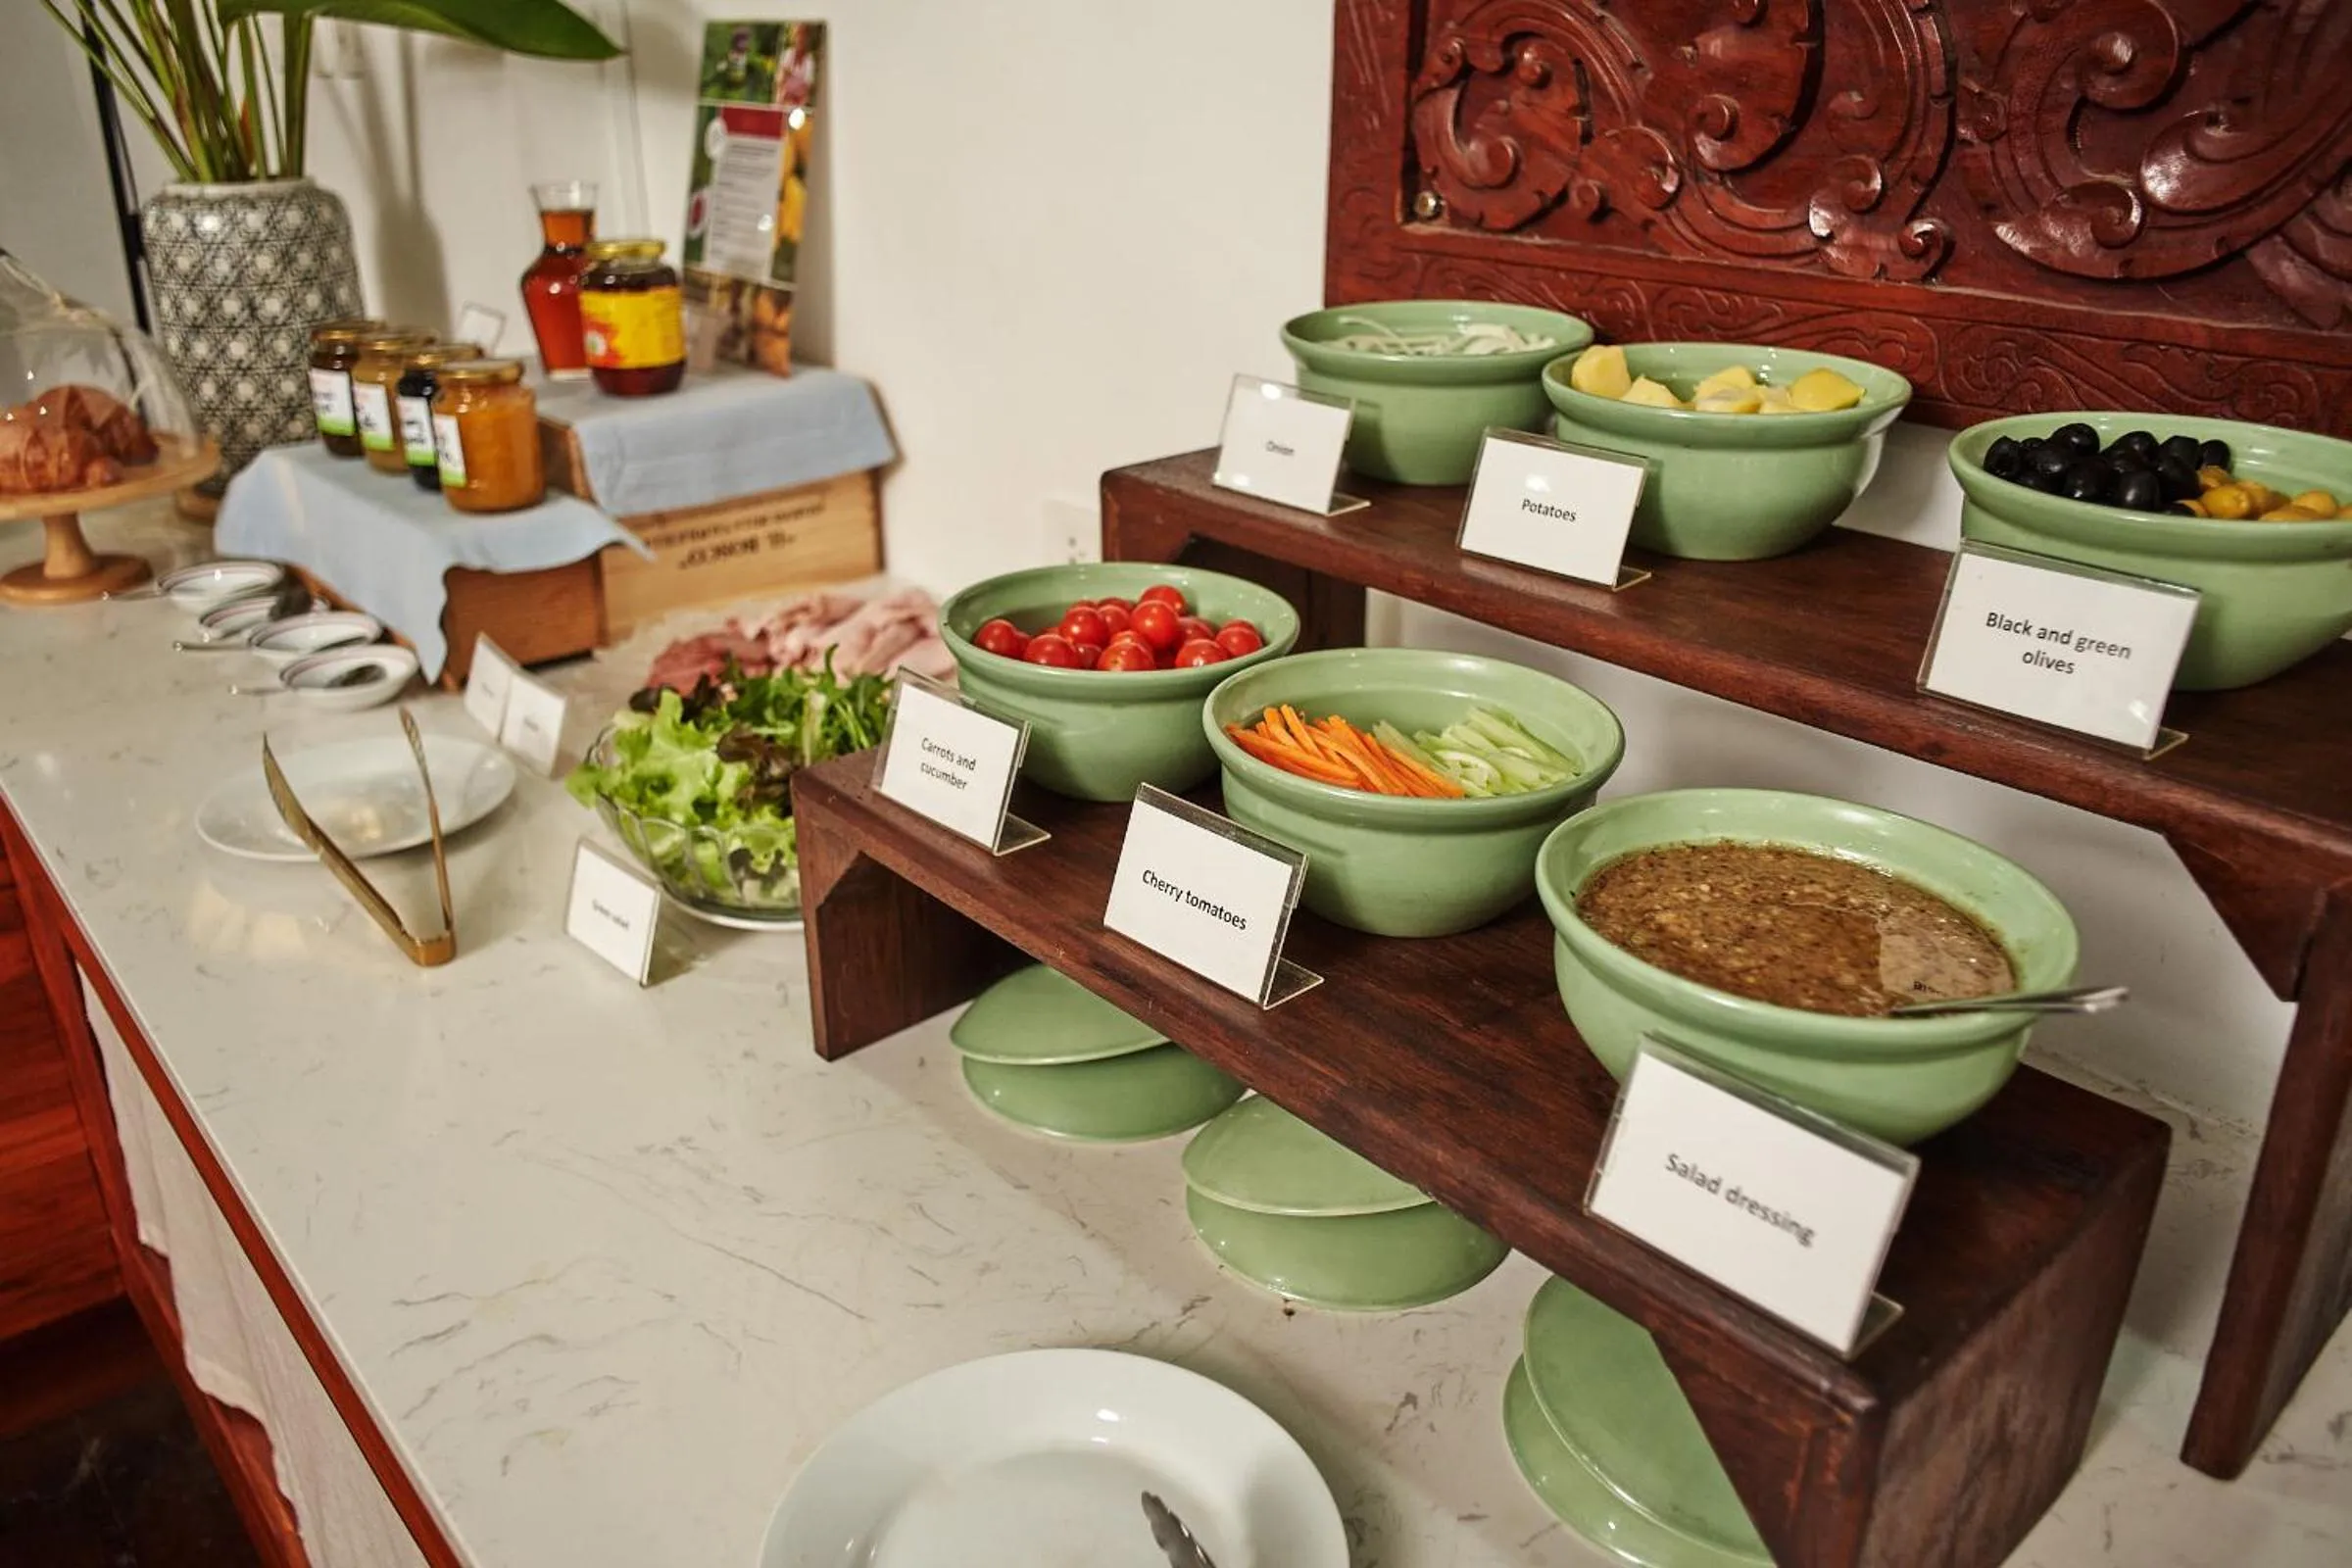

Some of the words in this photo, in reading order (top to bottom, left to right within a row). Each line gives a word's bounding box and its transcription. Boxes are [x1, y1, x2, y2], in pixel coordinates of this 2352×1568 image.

[1522, 498, 1577, 522] Potatoes
[1985, 612, 2033, 636] Black
[2036, 625, 2075, 645] and
[2074, 636, 2132, 660] green
[2022, 650, 2076, 674] olives
[921, 737, 955, 762] Carrots
[956, 754, 977, 771] and
[920, 761, 967, 790] cucumber
[1142, 869, 1184, 902] Cherry
[1185, 889, 1248, 930] tomatoes
[1665, 1152, 1723, 1196] Salad
[1725, 1186, 1817, 1248] dressing
